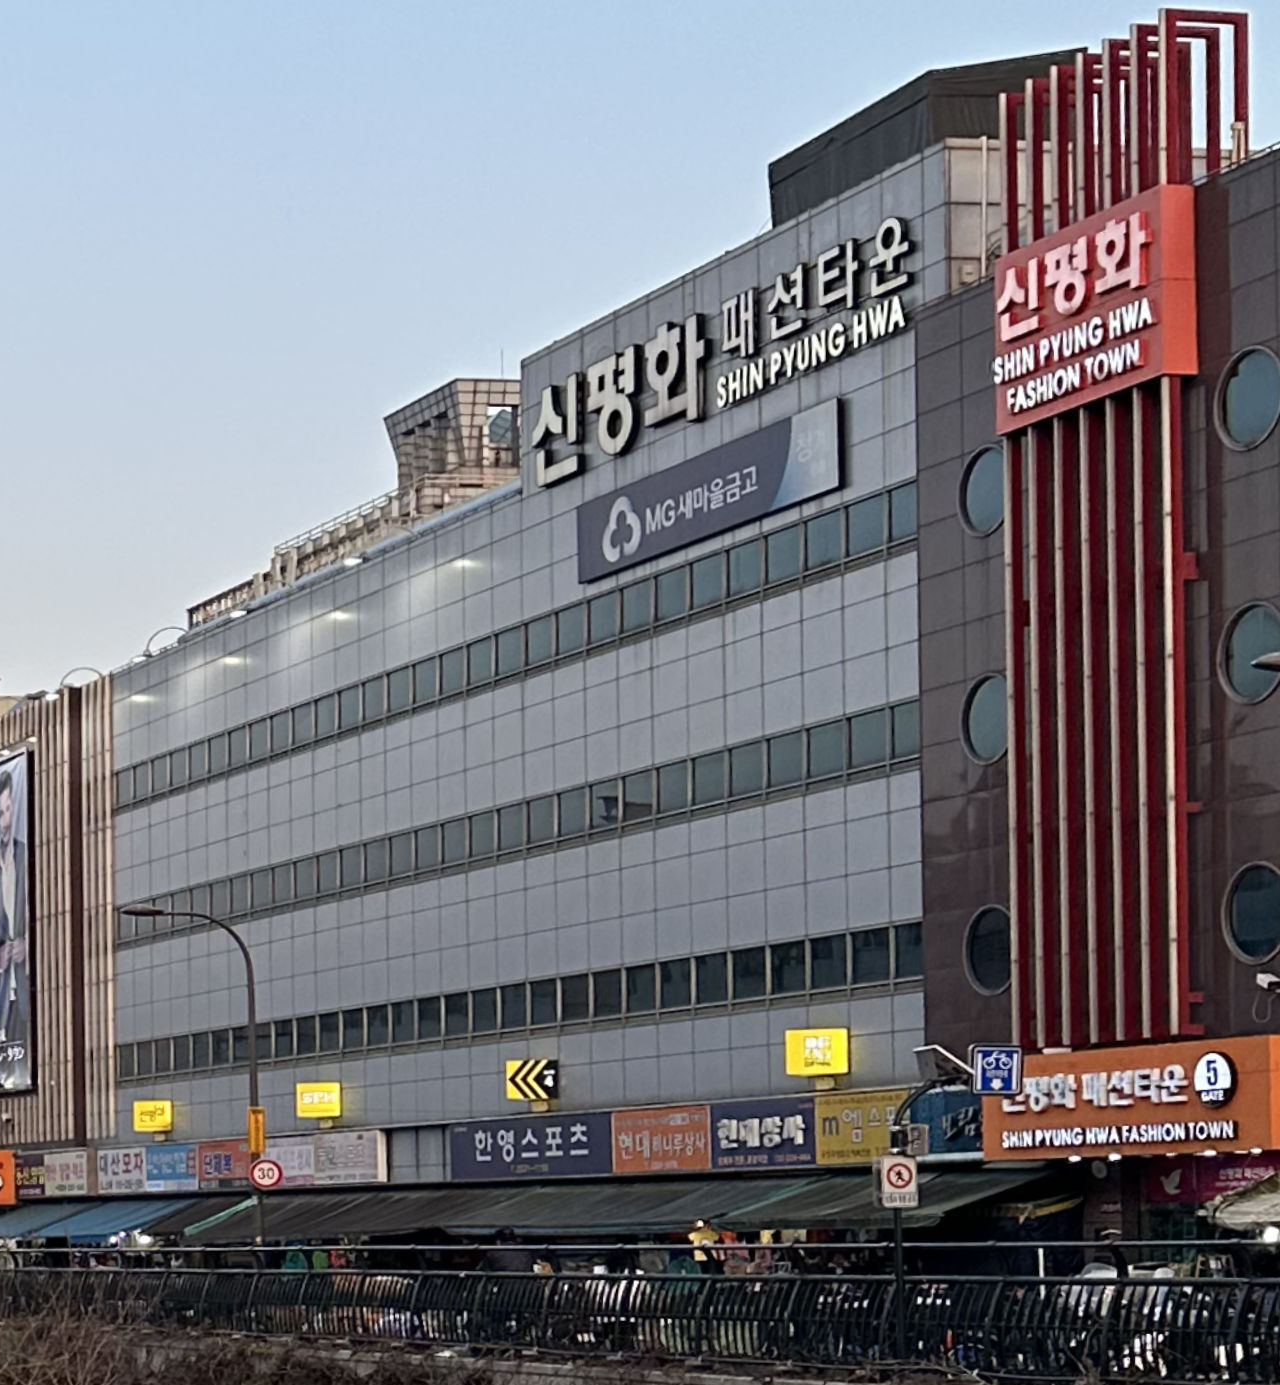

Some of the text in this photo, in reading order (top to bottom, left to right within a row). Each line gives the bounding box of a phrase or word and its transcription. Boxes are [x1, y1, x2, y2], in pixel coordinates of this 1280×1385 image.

[997, 211, 1153, 343] 신평화
[531, 216, 914, 488] 신평화 패션타운
[716, 296, 907, 409] SHIN PYUNG HWA
[992, 296, 1153, 386] SHIN PYUNG HWA
[1007, 339, 1142, 414] FASHION TOWN
[1081, 1064, 1189, 1107] 패션타운
[1205, 1060, 1218, 1086] 5
[1201, 1089, 1224, 1101] GATE
[474, 1123, 589, 1162] 한영스포츠
[717, 1114, 806, 1150] 현대상사
[1002, 1120, 1235, 1149] SHIN PYUNG HWA FASHION TOWN
[257, 1167, 275, 1180] 30
